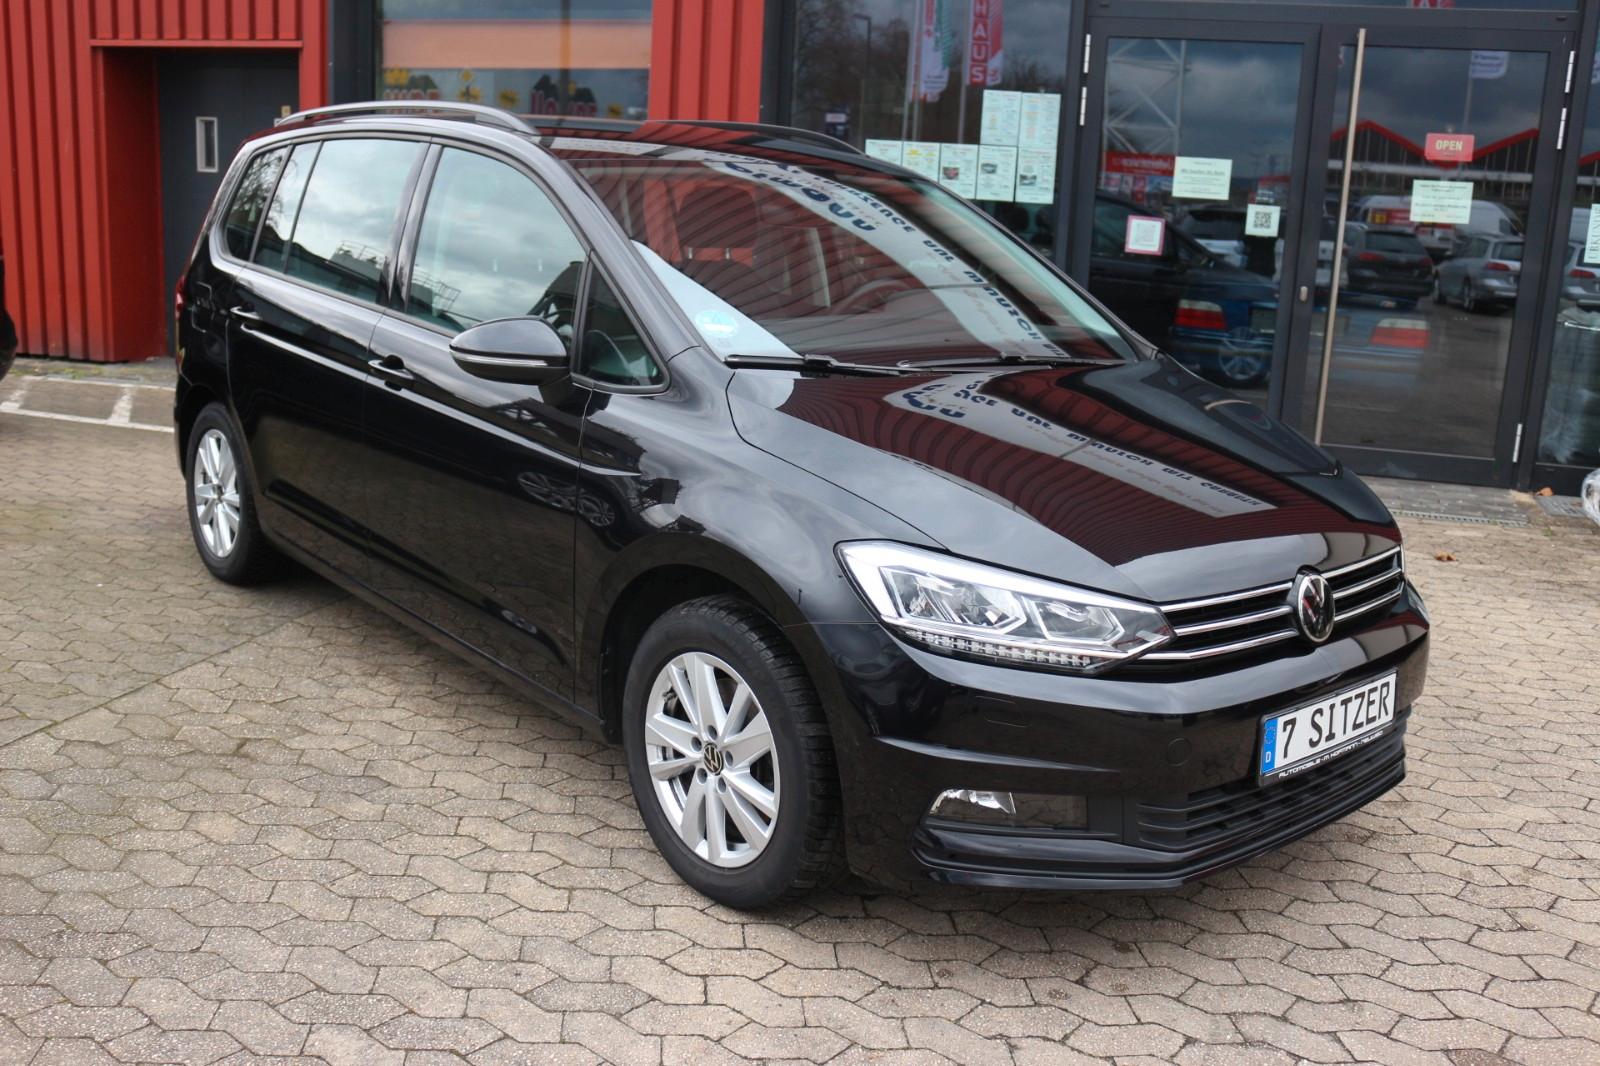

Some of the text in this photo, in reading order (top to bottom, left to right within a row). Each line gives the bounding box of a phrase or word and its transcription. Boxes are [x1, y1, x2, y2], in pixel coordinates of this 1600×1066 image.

[1436, 139, 1463, 152] OPEN
[1282, 681, 1390, 759] 7 SITZER
[1265, 751, 1272, 763] D
